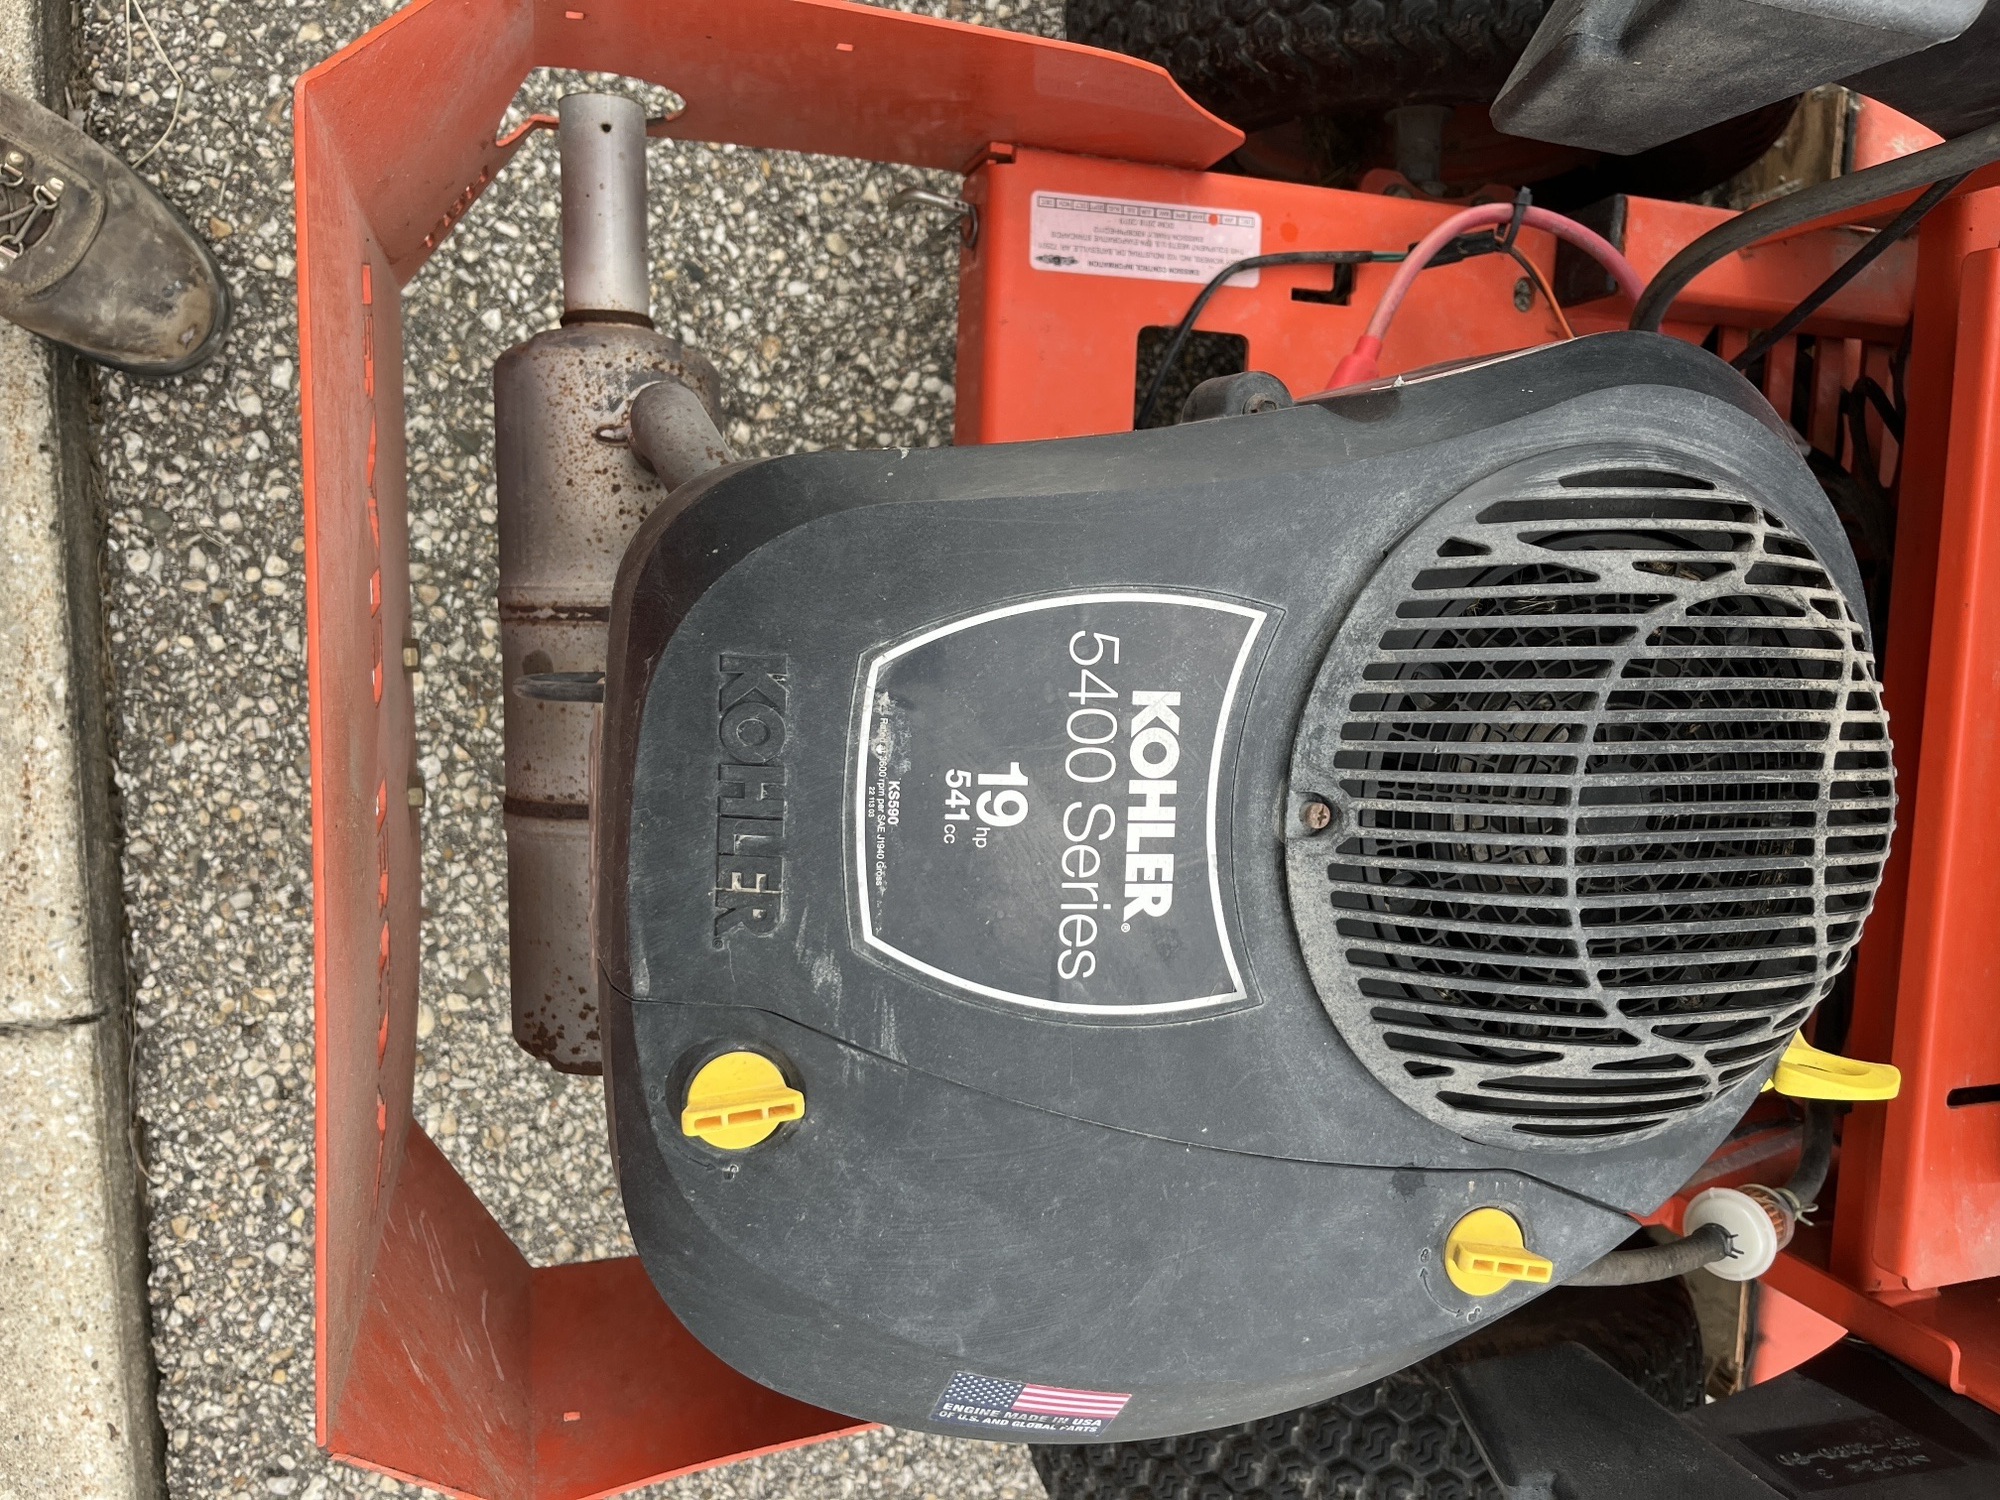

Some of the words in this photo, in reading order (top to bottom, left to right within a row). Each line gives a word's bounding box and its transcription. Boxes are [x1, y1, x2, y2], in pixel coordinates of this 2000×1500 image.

[1064, 629, 1121, 784] 5400
[879, 717, 889, 743] Rated
[878, 755, 888, 777] 3600
[713, 653, 788, 937] KOHLER
[868, 786, 876, 795] 22
[876, 778, 886, 796] rpm
[944, 768, 972, 821] 541
[868, 809, 875, 818] 03
[876, 798, 885, 813] per
[886, 781, 900, 825] KS590
[877, 814, 886, 833] SAE
[876, 834, 886, 859] J1940
[875, 861, 884, 886] Gross
[1056, 801, 1116, 980] Series
[938, 1411, 955, 1419] OF
[957, 1414, 980, 1423] U.S.
[983, 1417, 1009, 1426] AND
[1011, 1420, 1057, 1430] GLOBAL
[1058, 1424, 1098, 1434] PARTS
[942, 1403, 1001, 1418] ENGINE
[1003, 1411, 1049, 1423] MADE
[1052, 1416, 1070, 1425] IN
[1072, 1418, 1102, 1427] USA
